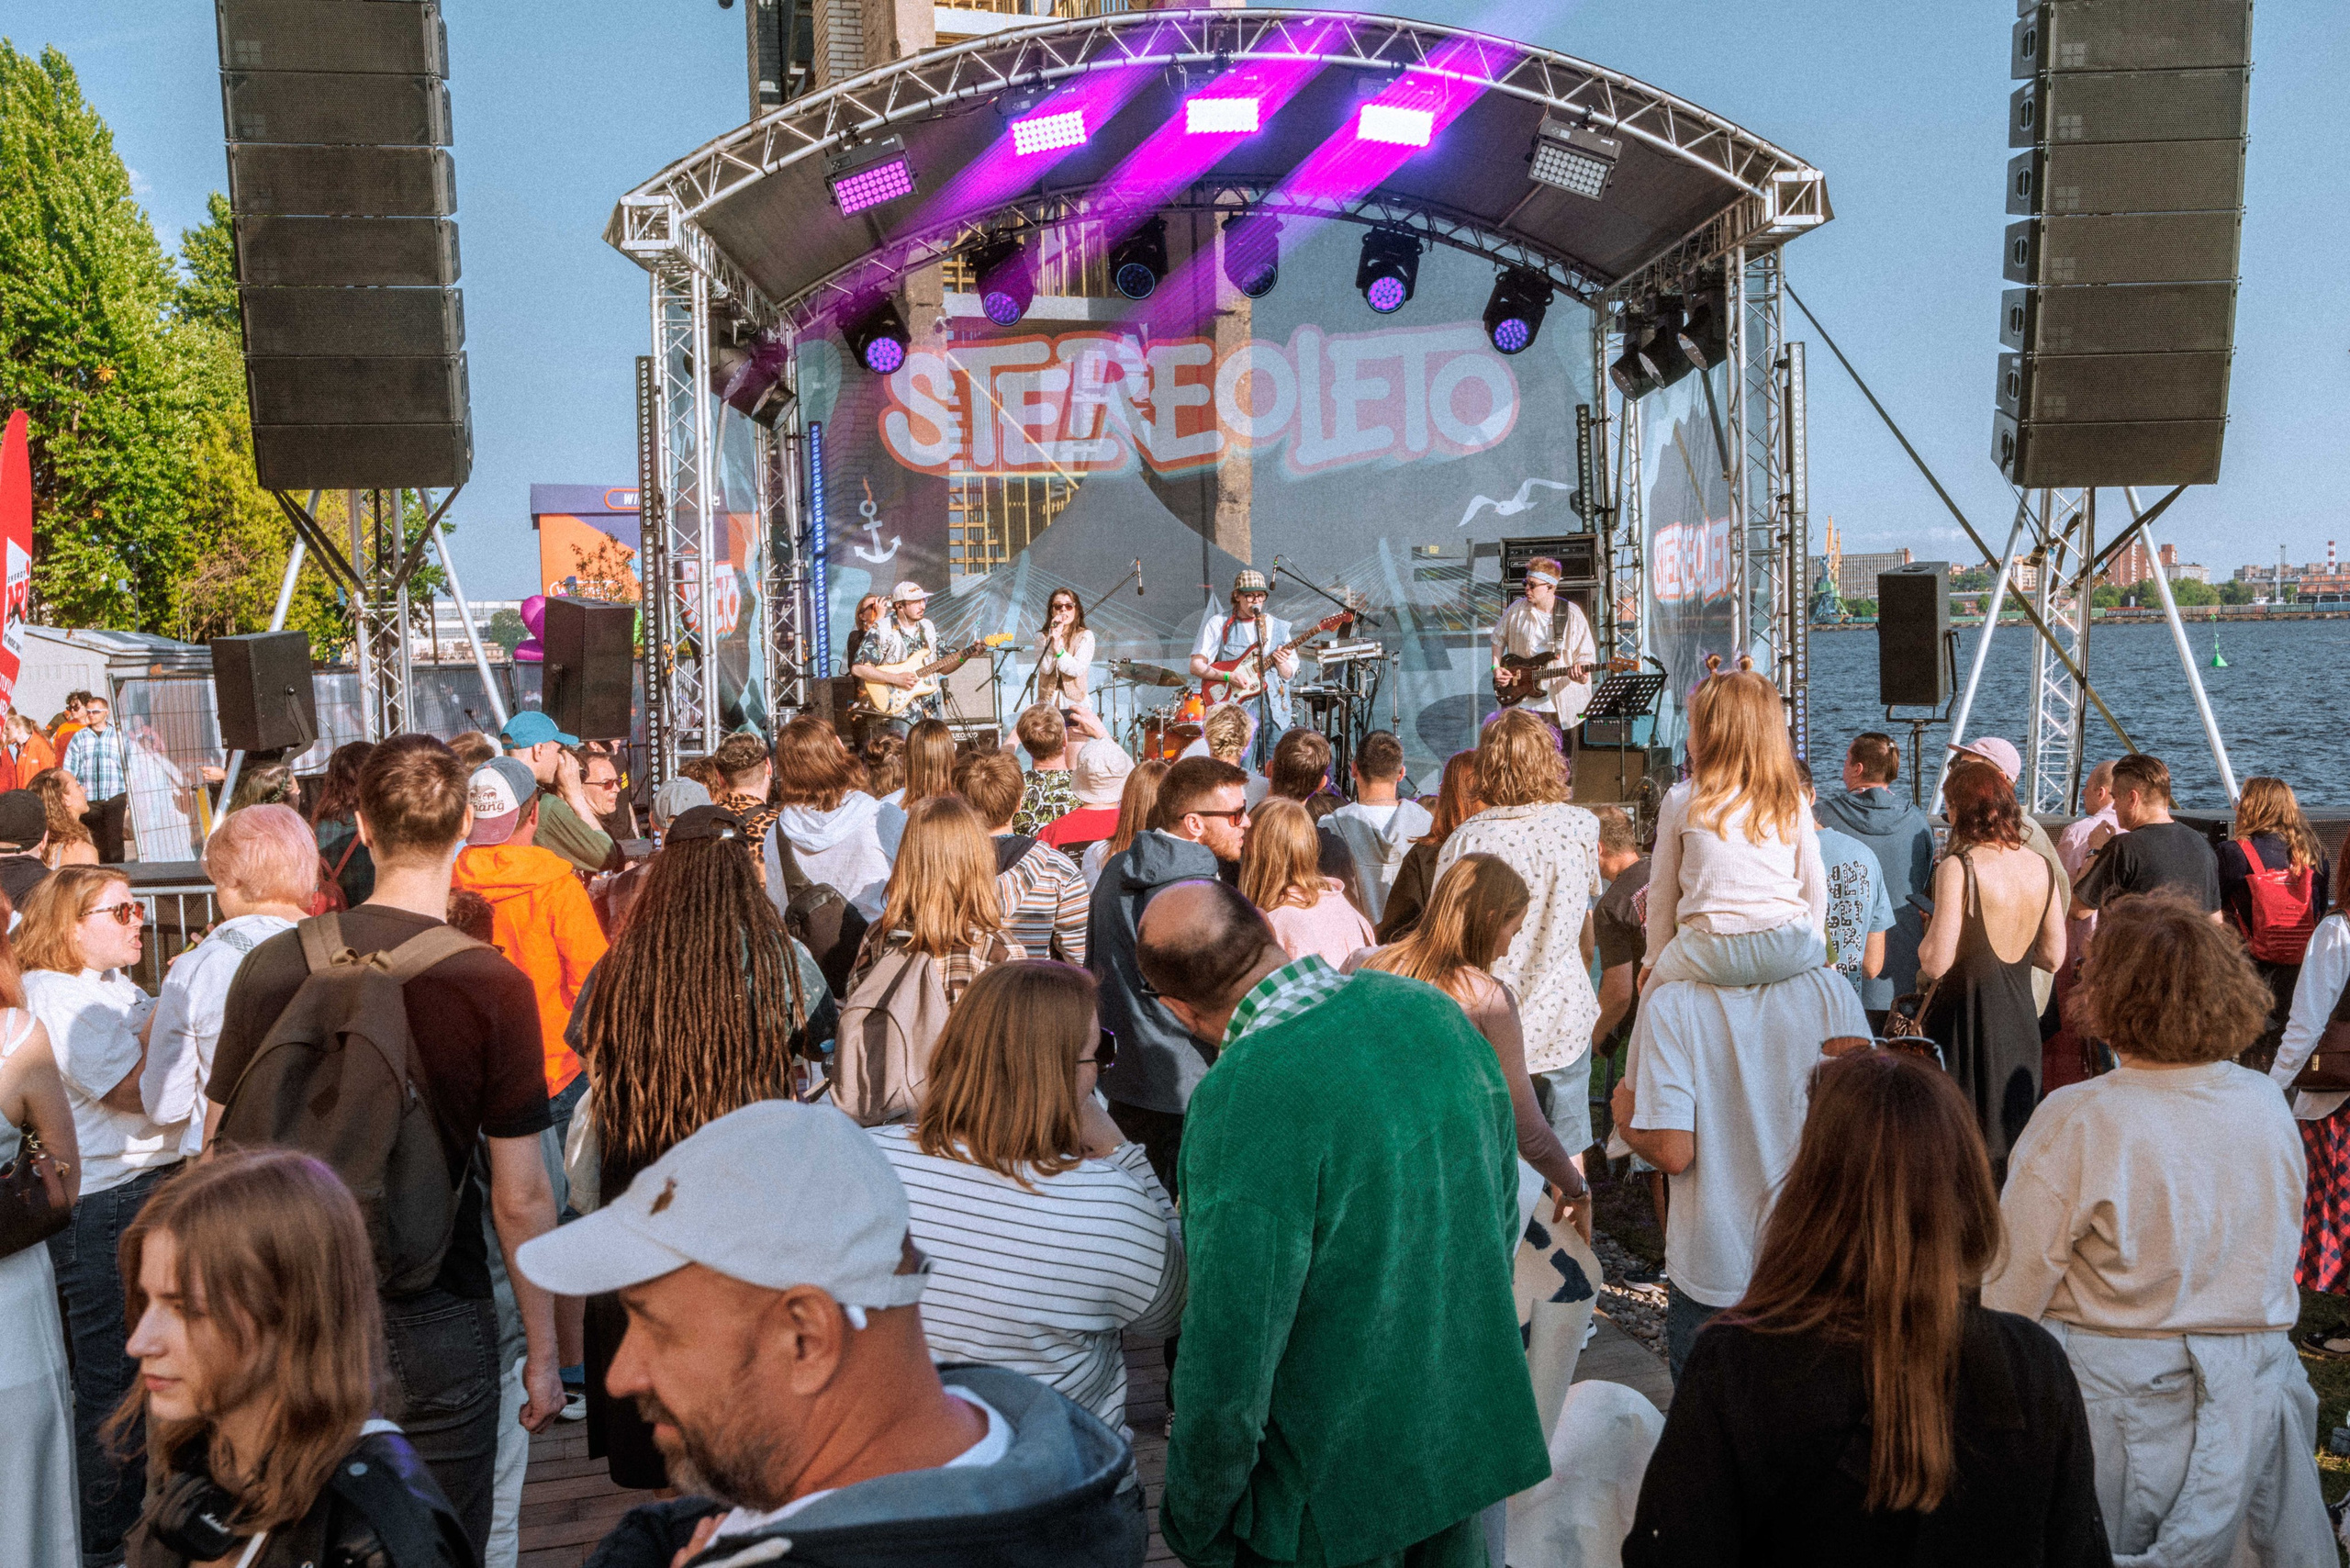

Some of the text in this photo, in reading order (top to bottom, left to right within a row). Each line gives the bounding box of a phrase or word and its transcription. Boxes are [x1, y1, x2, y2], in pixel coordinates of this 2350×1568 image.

[880, 326, 1519, 474] STEREOLETO
[1653, 517, 1730, 602] STEREOLET
[474, 801, 504, 812] hang
